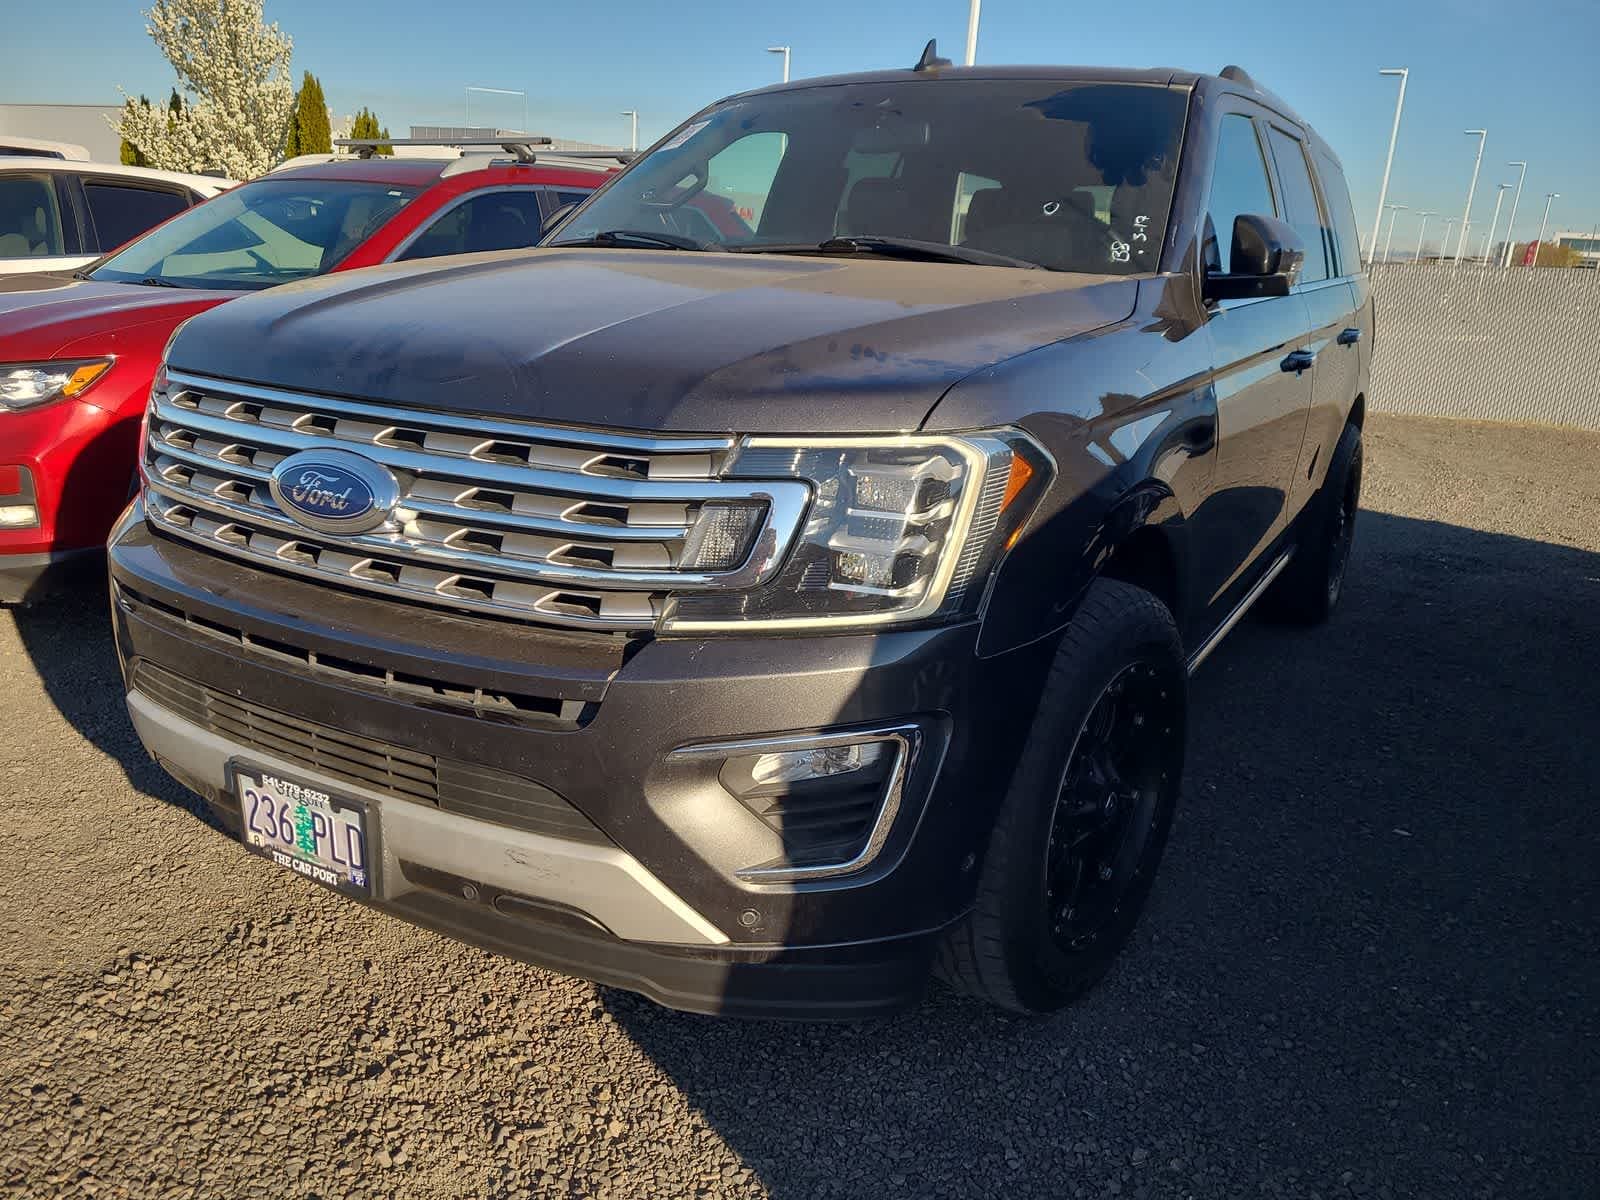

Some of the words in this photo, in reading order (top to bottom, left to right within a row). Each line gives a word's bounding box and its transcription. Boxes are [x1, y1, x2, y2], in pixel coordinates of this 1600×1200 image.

[292, 470, 353, 511] Ford
[245, 789, 294, 845] 236
[311, 811, 364, 870] PLD
[272, 851, 292, 868] THE
[292, 859, 312, 876] CAR
[312, 866, 338, 886] PORT
